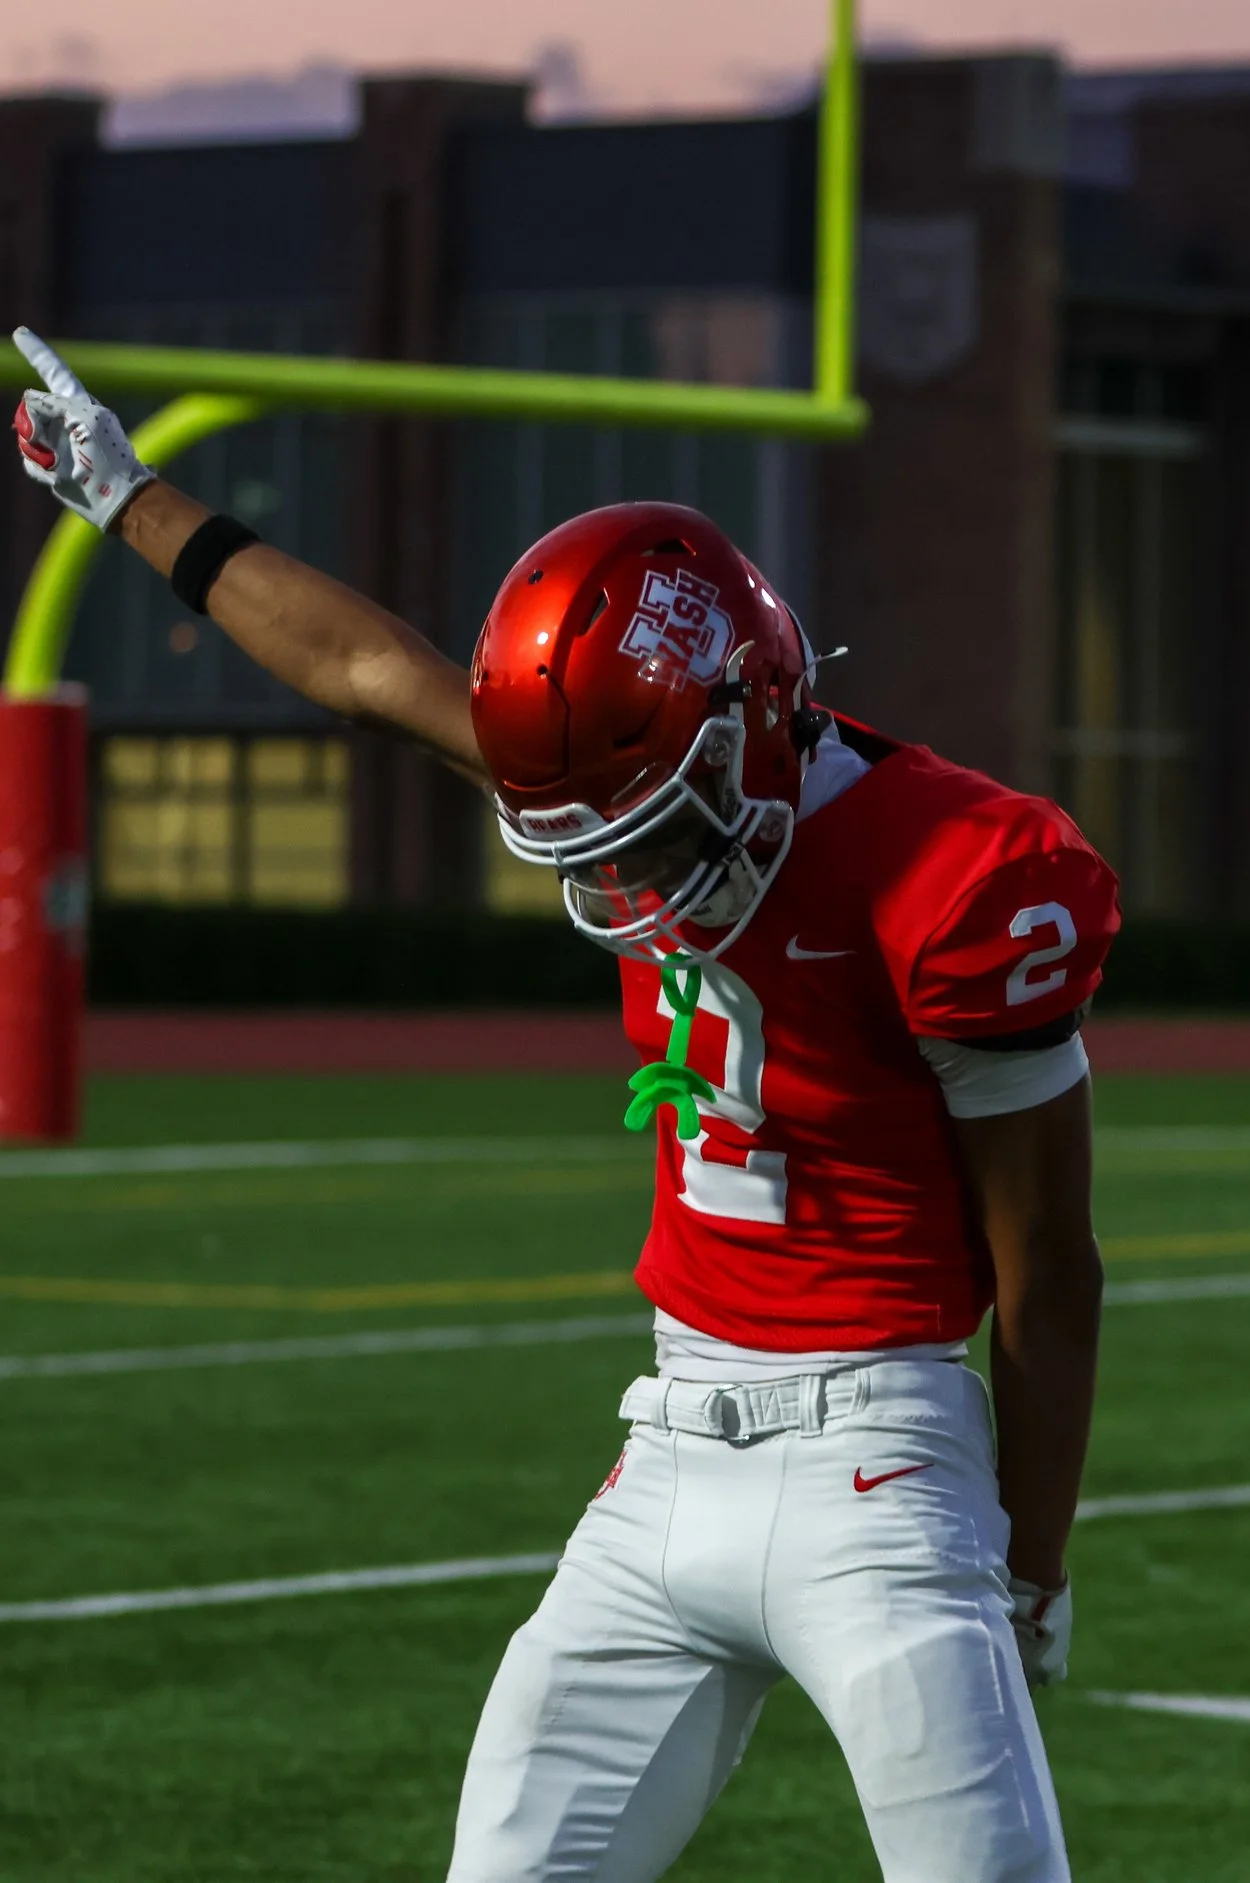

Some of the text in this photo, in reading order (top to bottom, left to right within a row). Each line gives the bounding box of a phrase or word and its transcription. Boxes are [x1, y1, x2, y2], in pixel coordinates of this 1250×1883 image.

[618, 569, 736, 687] U
[638, 568, 720, 693] WASH
[1005, 901, 1078, 1007] 2
[656, 946, 788, 1225] 2
